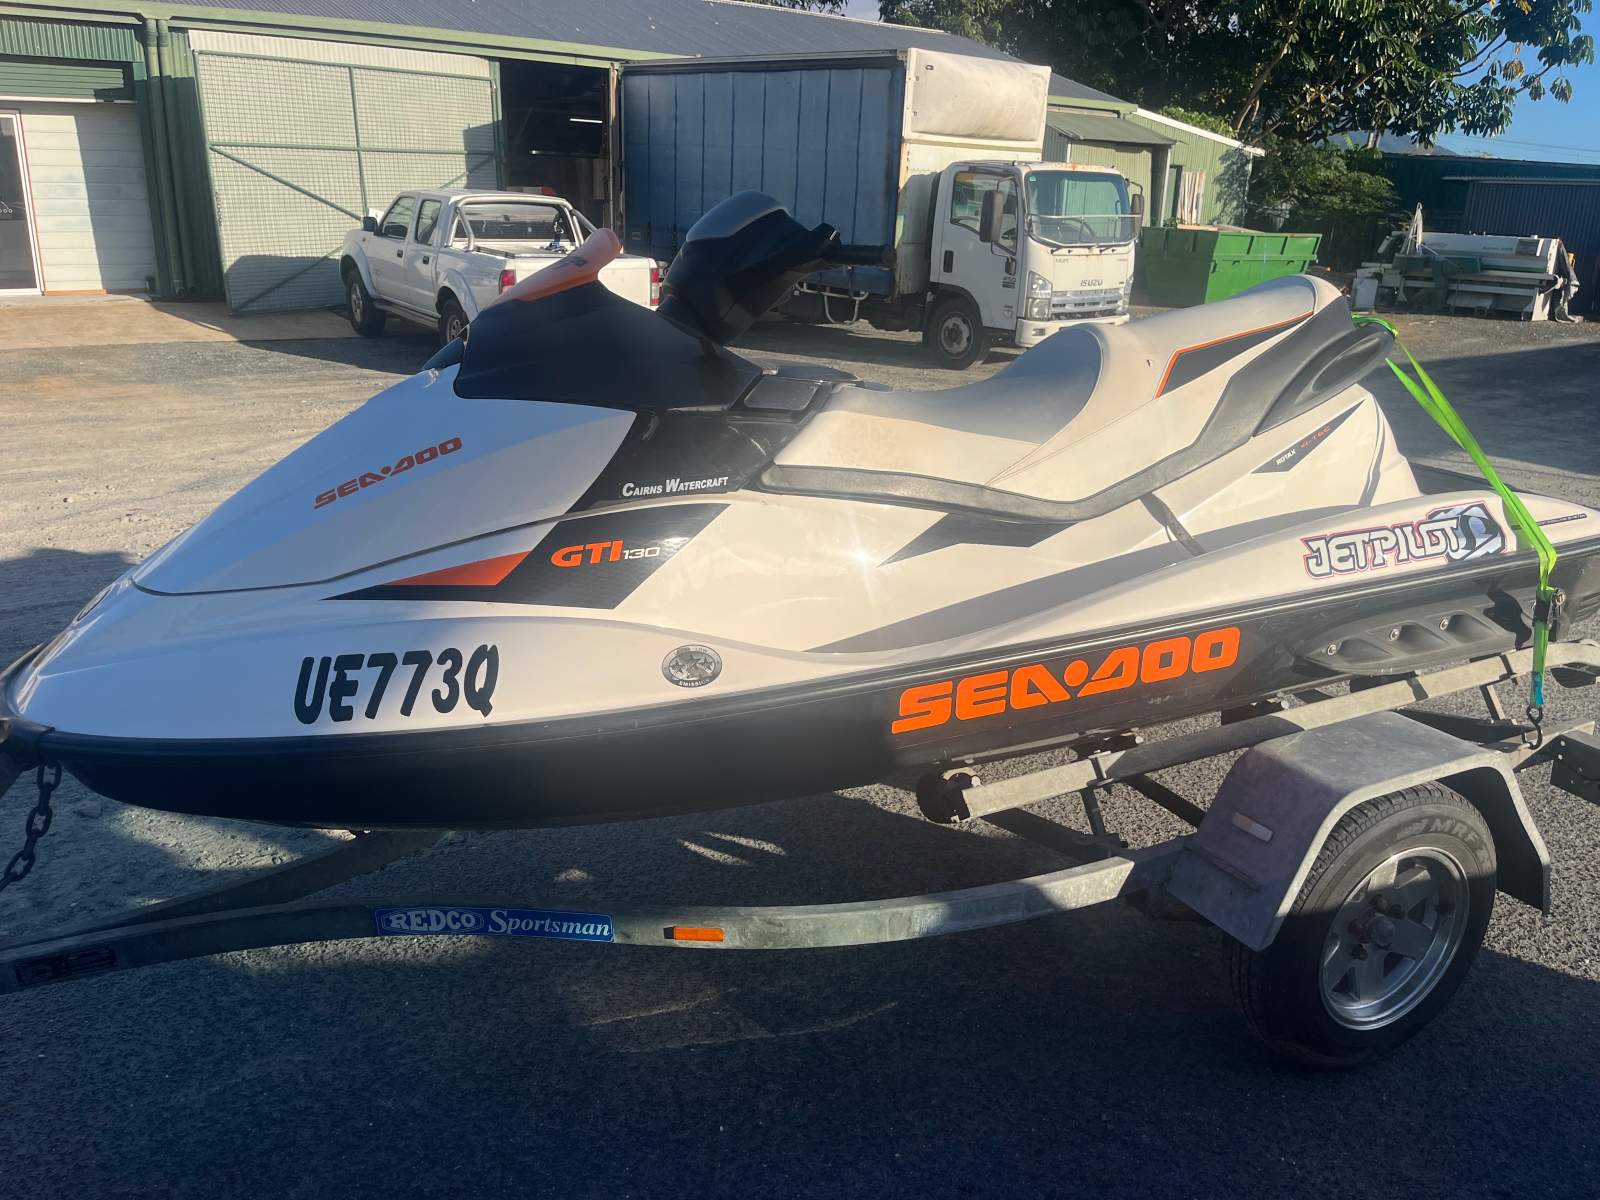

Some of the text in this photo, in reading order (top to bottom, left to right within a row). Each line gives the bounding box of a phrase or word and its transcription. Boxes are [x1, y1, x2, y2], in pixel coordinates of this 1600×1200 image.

[1080, 279, 1103, 287] ISUZU
[1276, 449, 1297, 465] ROTAX
[622, 476, 729, 497] CAIRNS WATERCRAFT
[550, 539, 660, 568] GTI 130
[1303, 515, 1462, 578] JETPILOT
[294, 643, 500, 725] UE773Q
[1429, 818, 1480, 843] MRF
[389, 909, 610, 937] REDCO Sportsman
